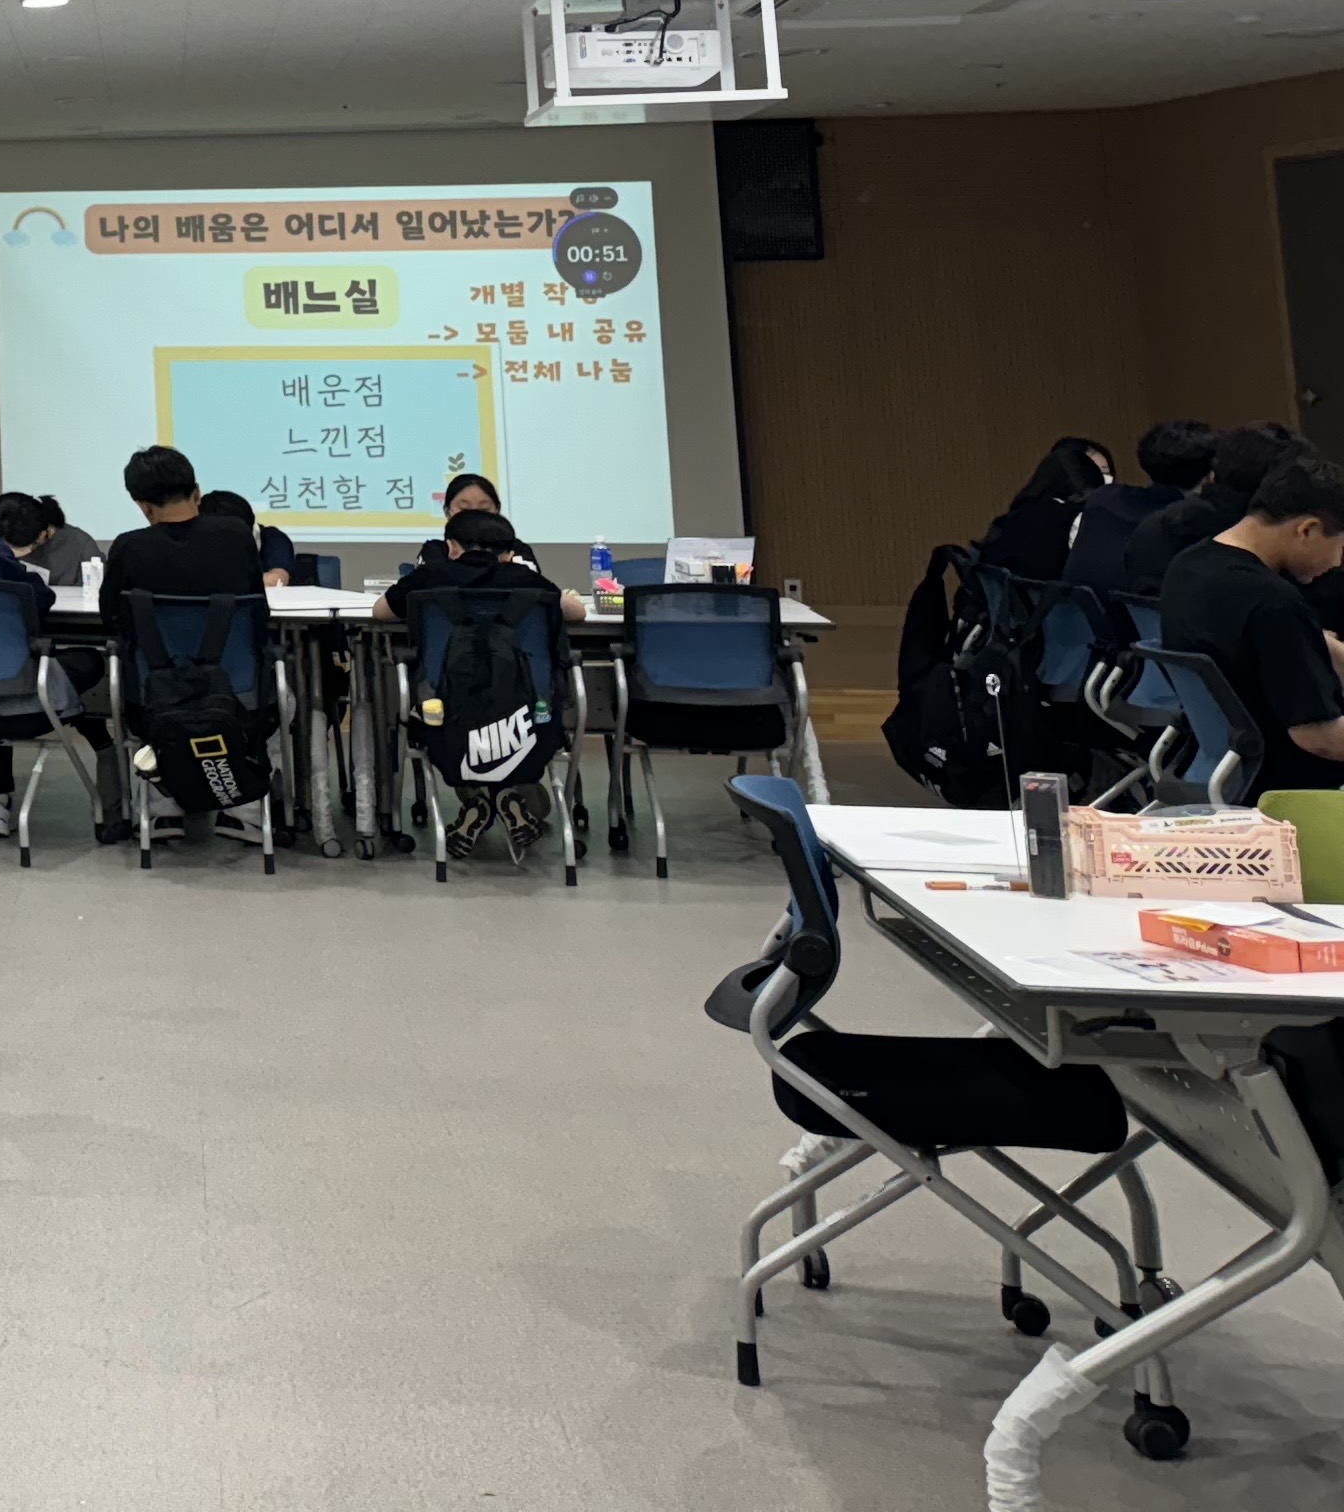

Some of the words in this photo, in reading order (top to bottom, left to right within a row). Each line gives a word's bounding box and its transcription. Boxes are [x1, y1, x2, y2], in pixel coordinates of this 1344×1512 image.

[99, 215, 160, 243] 나의
[175, 213, 269, 243] 배움은
[285, 212, 379, 241] 어디서
[567, 245, 628, 263] 00:51
[263, 279, 379, 315] 배느실
[470, 281, 526, 308] 개별
[476, 320, 529, 345] 모둠
[547, 322, 574, 342] 내
[593, 319, 647, 345] 공유
[504, 360, 561, 383] 전체
[576, 358, 632, 383] 나눔
[282, 374, 383, 408] 배운점
[282, 425, 385, 458] 느낀점
[260, 475, 366, 510] 실천할
[386, 476, 414, 510] 점
[468, 704, 537, 766] NIKE
